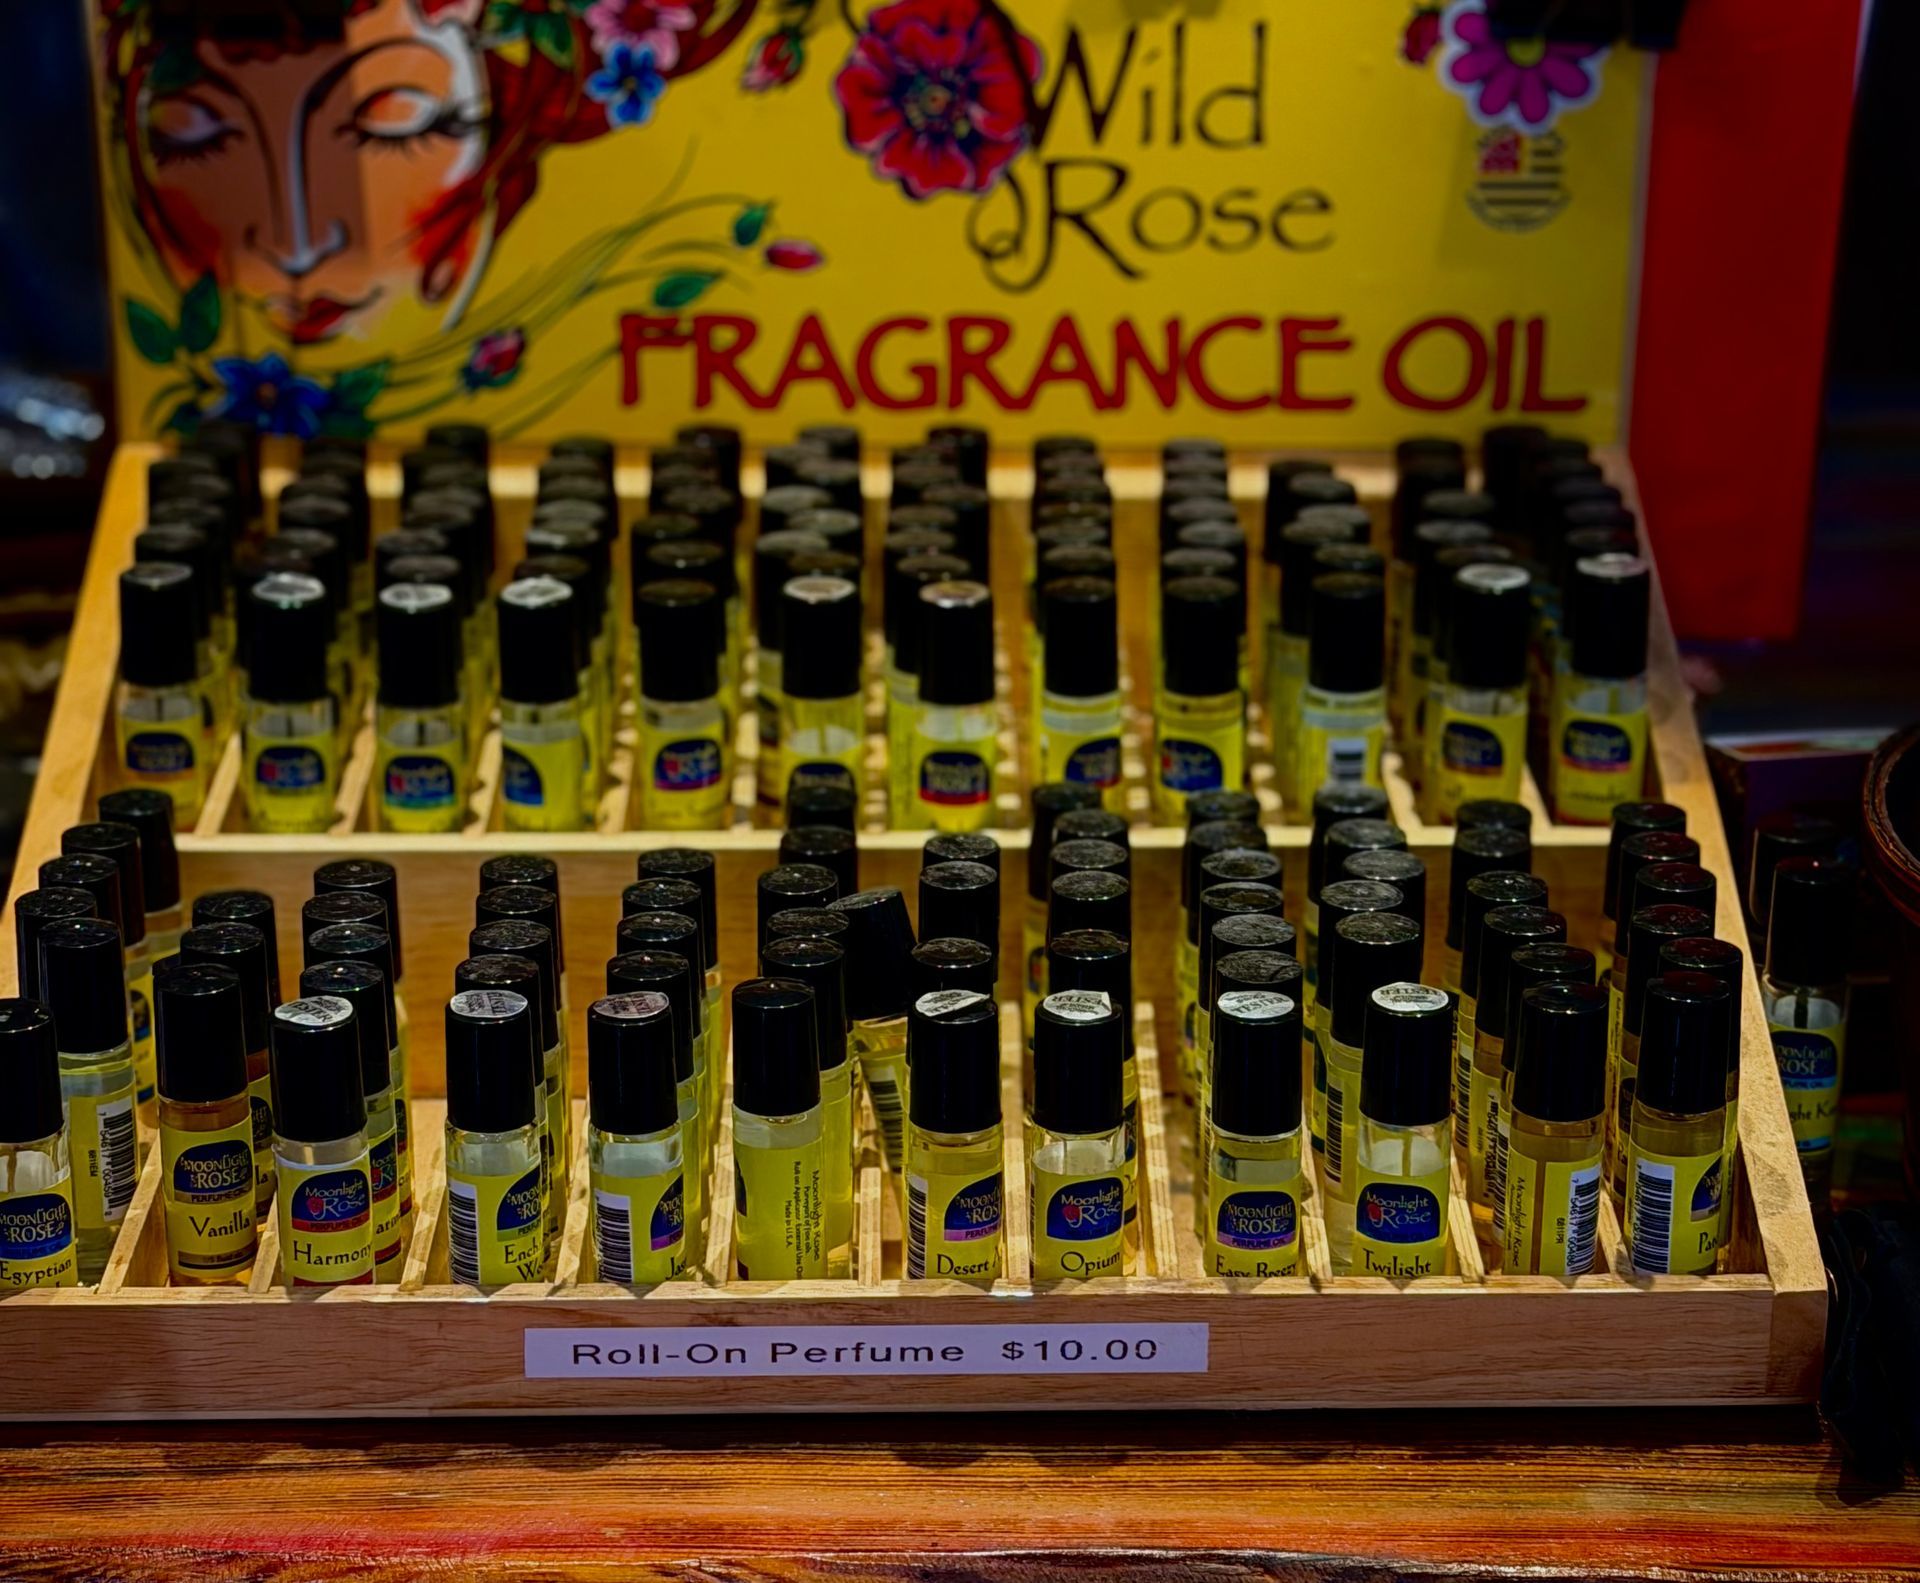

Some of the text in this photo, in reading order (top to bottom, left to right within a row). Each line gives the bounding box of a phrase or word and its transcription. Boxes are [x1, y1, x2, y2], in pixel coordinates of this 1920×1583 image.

[1000, 18, 1266, 158] Wild
[966, 157, 1335, 293] Rose
[618, 312, 1588, 412] FRAGRANCE OIL
[197, 1167, 241, 1189] ROSE
[306, 1194, 366, 1221] Rose
[1061, 1186, 1120, 1206] Moonlight
[1366, 1191, 1429, 1213] Moonlight
[189, 1210, 250, 1238] Vanilla
[971, 1204, 999, 1225] ROS
[1064, 1202, 1121, 1229] Rose
[1238, 1218, 1281, 1235] ROSE
[1370, 1205, 1432, 1229] Rose
[8, 1220, 56, 1244] ROSE
[504, 1237, 540, 1264] Ench
[1060, 1251, 1121, 1276] Opium
[1362, 1247, 1431, 1277] Twilight
[0, 1258, 72, 1286] Egyptian
[937, 1253, 990, 1276] Desert
[572, 1338, 1158, 1365] Roll-On Perfume $10.00
